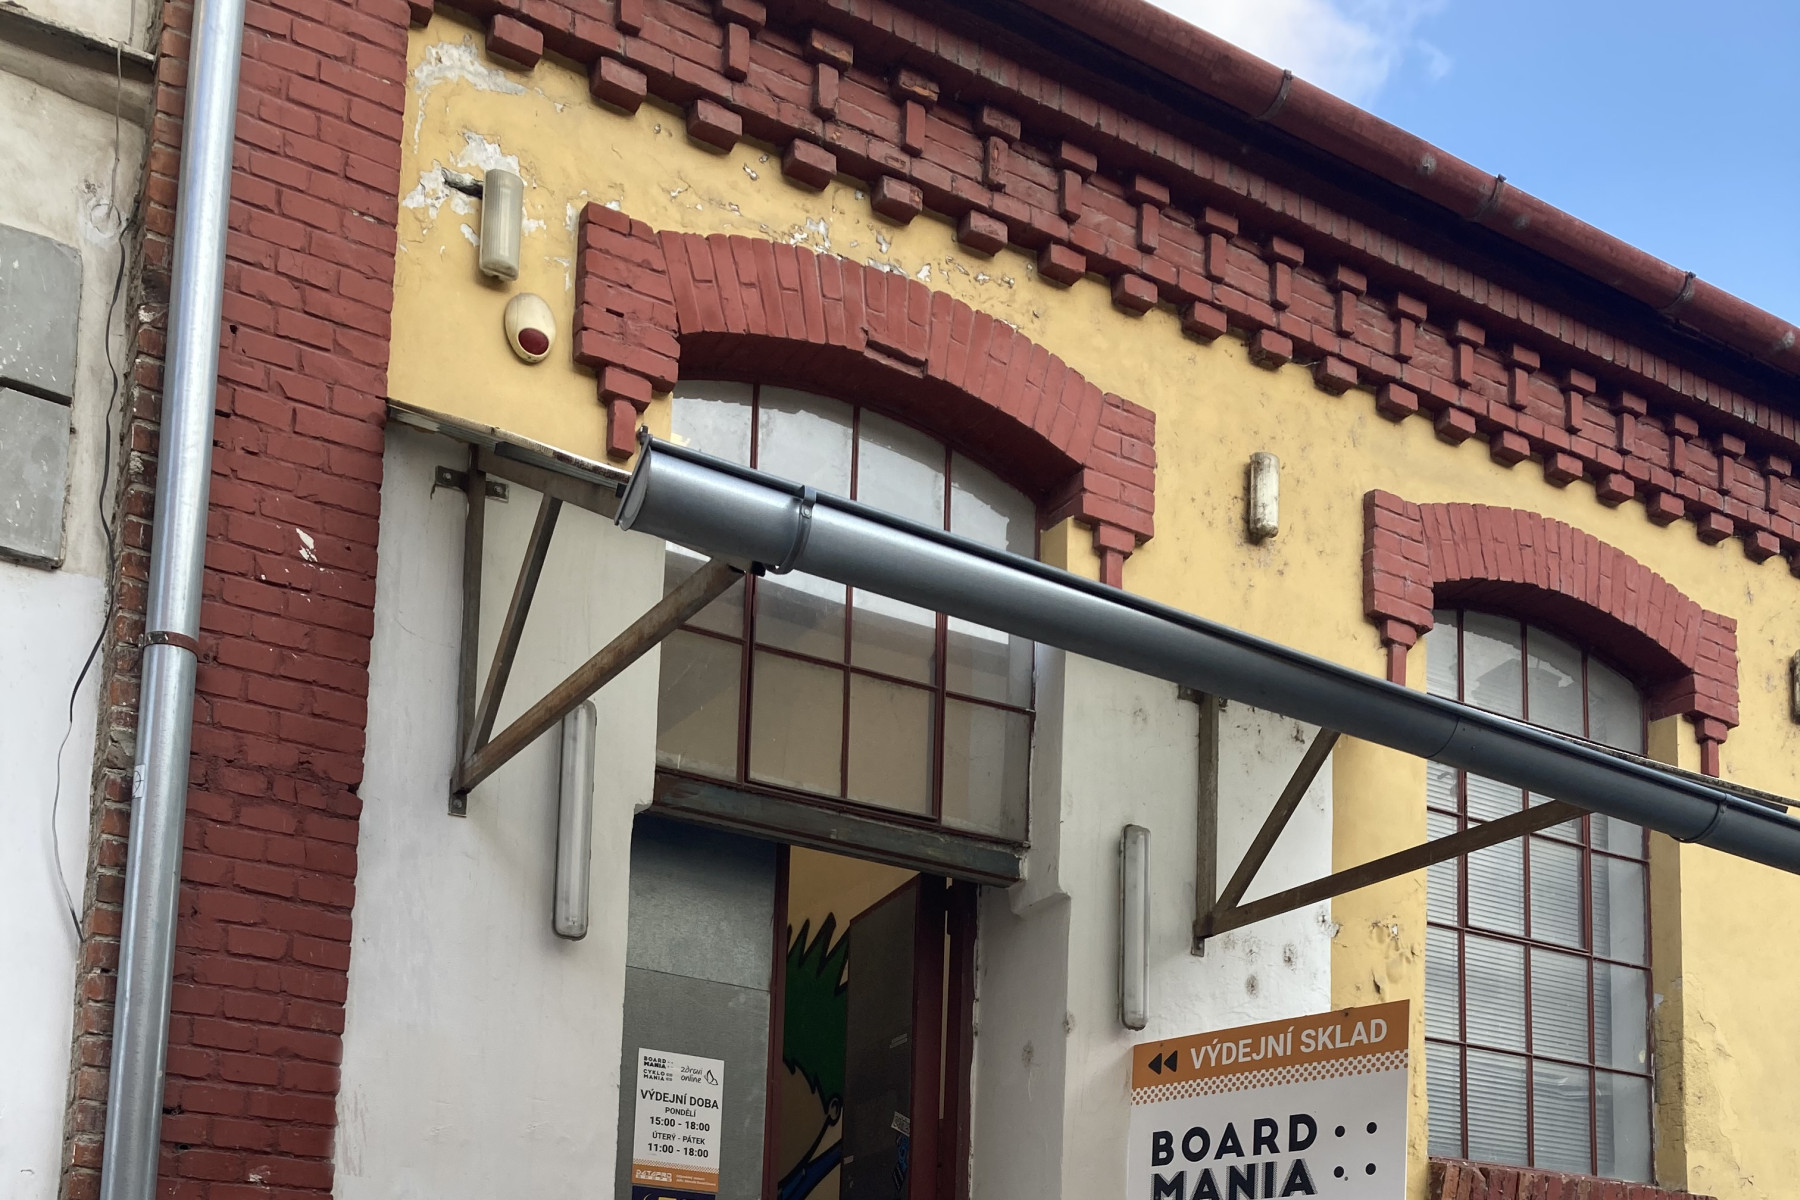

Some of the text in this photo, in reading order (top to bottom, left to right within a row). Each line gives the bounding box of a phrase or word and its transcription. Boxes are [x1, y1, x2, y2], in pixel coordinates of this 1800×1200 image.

[1190, 1018, 1388, 1070] VÝDEJNÍ SKLAD
[643, 1056, 667, 1064] BOARD
[643, 1061, 666, 1069] MANIA
[681, 1075, 702, 1083] online
[640, 1088, 719, 1109] VÝDEJNÍ DOBA
[665, 1107, 696, 1117] PONDĚLÍ
[650, 1116, 676, 1127] 15:00
[685, 1121, 710, 1132] 18:00
[652, 1131, 676, 1141] ÚTERÝ
[682, 1135, 705, 1145] PÁTEK
[1151, 1113, 1318, 1167] BOARD
[648, 1143, 674, 1154] 11:00
[684, 1147, 709, 1158] 18:00
